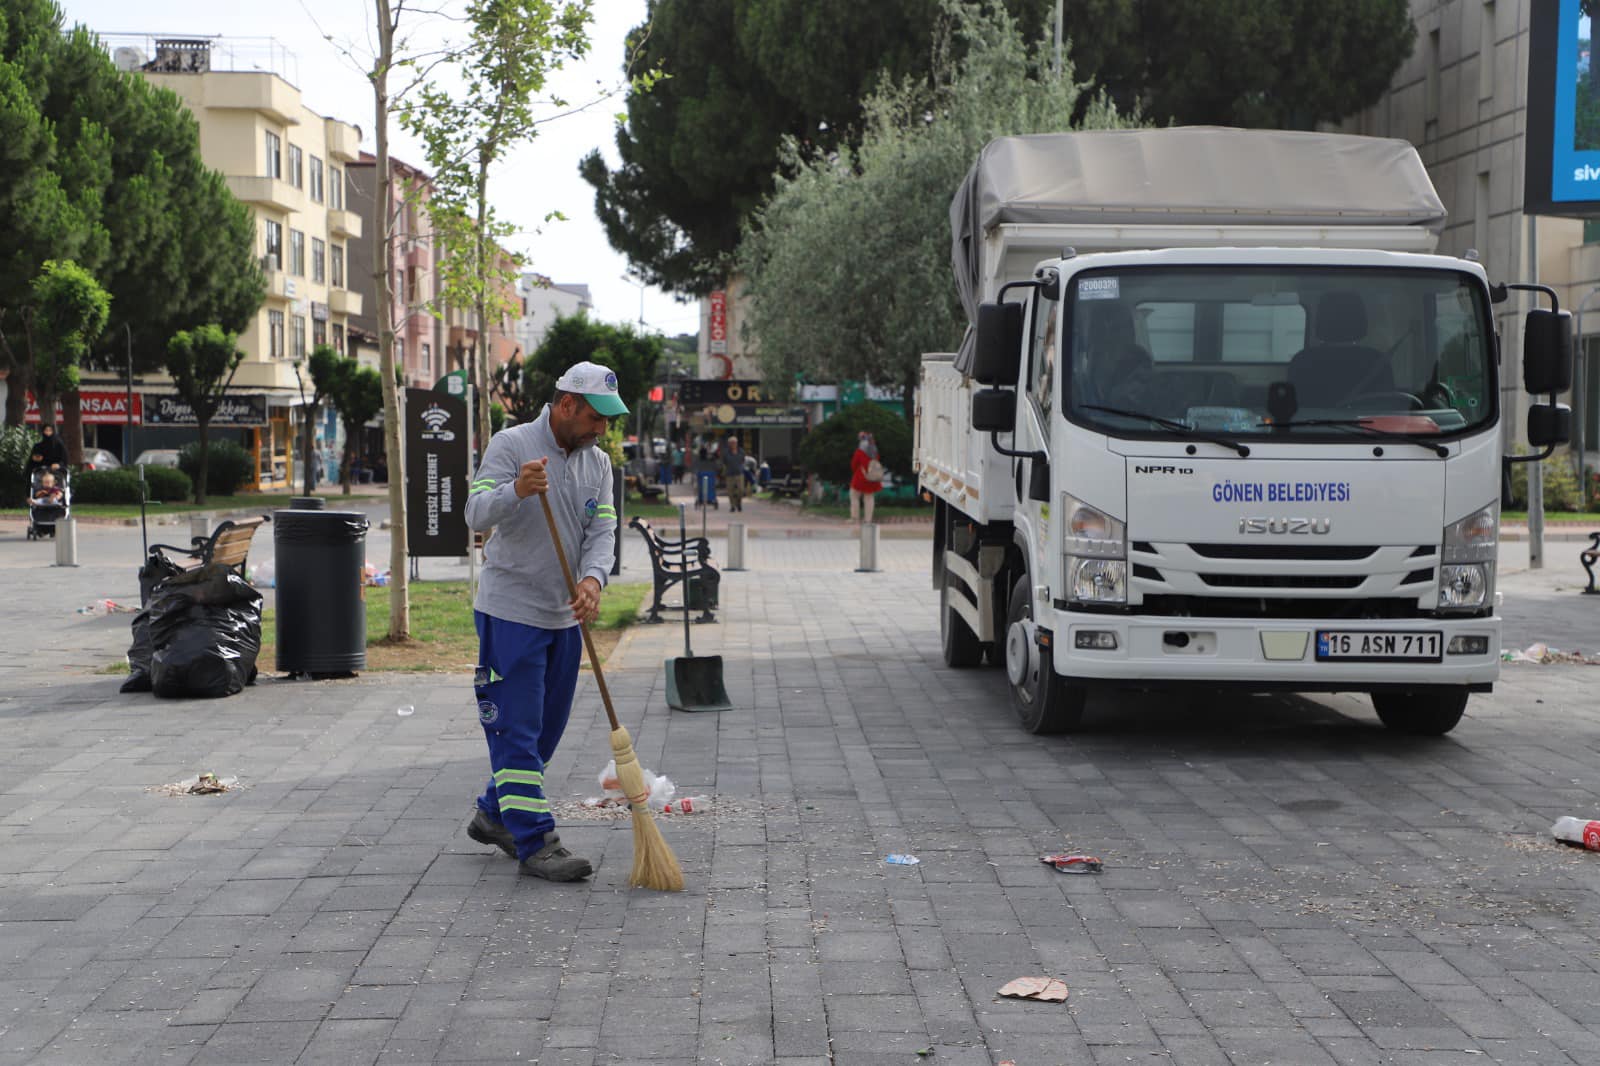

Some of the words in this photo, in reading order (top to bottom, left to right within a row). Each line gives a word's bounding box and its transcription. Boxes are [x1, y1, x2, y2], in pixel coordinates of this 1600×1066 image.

[447, 375, 464, 394] B
[426, 453, 438, 494] İNTERNET
[1135, 465, 1175, 475] NPR
[1179, 467, 1194, 475] 10
[441, 476, 452, 513] BURADA
[1212, 480, 1263, 503] GÖNEN
[426, 495, 439, 536] ÜCRETSİZ
[1238, 517, 1331, 535] ISUZU
[1330, 635, 1351, 654] 16
[1361, 635, 1396, 654] ASN
[1403, 635, 1437, 654] 711
